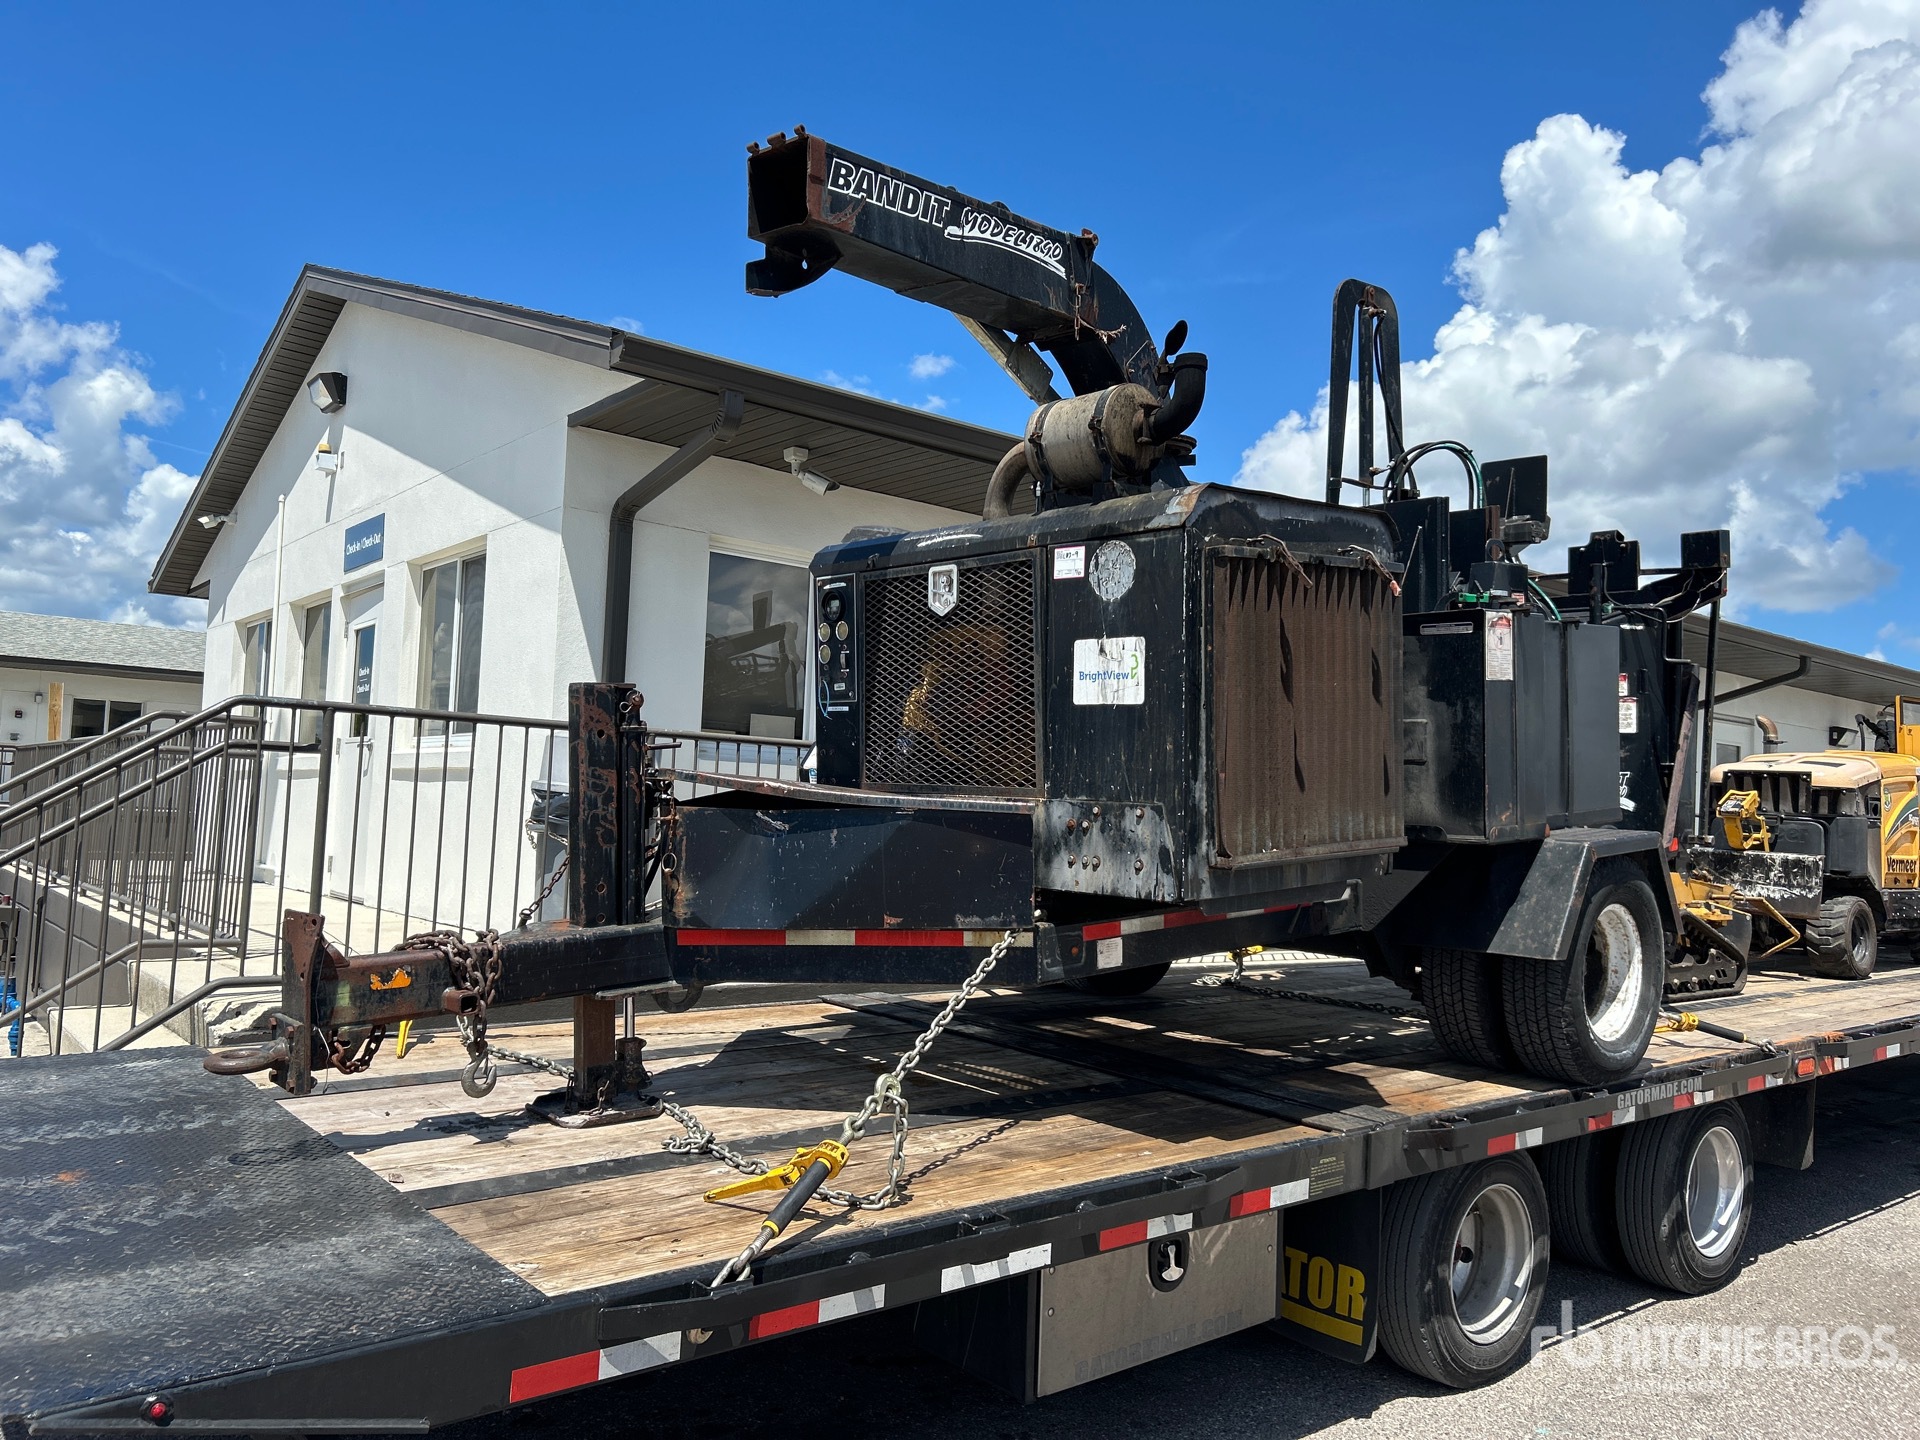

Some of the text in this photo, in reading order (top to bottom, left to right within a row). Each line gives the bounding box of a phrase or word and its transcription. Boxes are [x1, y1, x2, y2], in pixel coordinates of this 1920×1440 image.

[827, 158, 951, 228] BANDIT
[1079, 671, 1130, 682] BrightView
[1887, 857, 1917, 873] Vermeer
[1617, 1076, 1703, 1109] GATORMADE.COM
[1281, 1245, 1366, 1322] TOR
